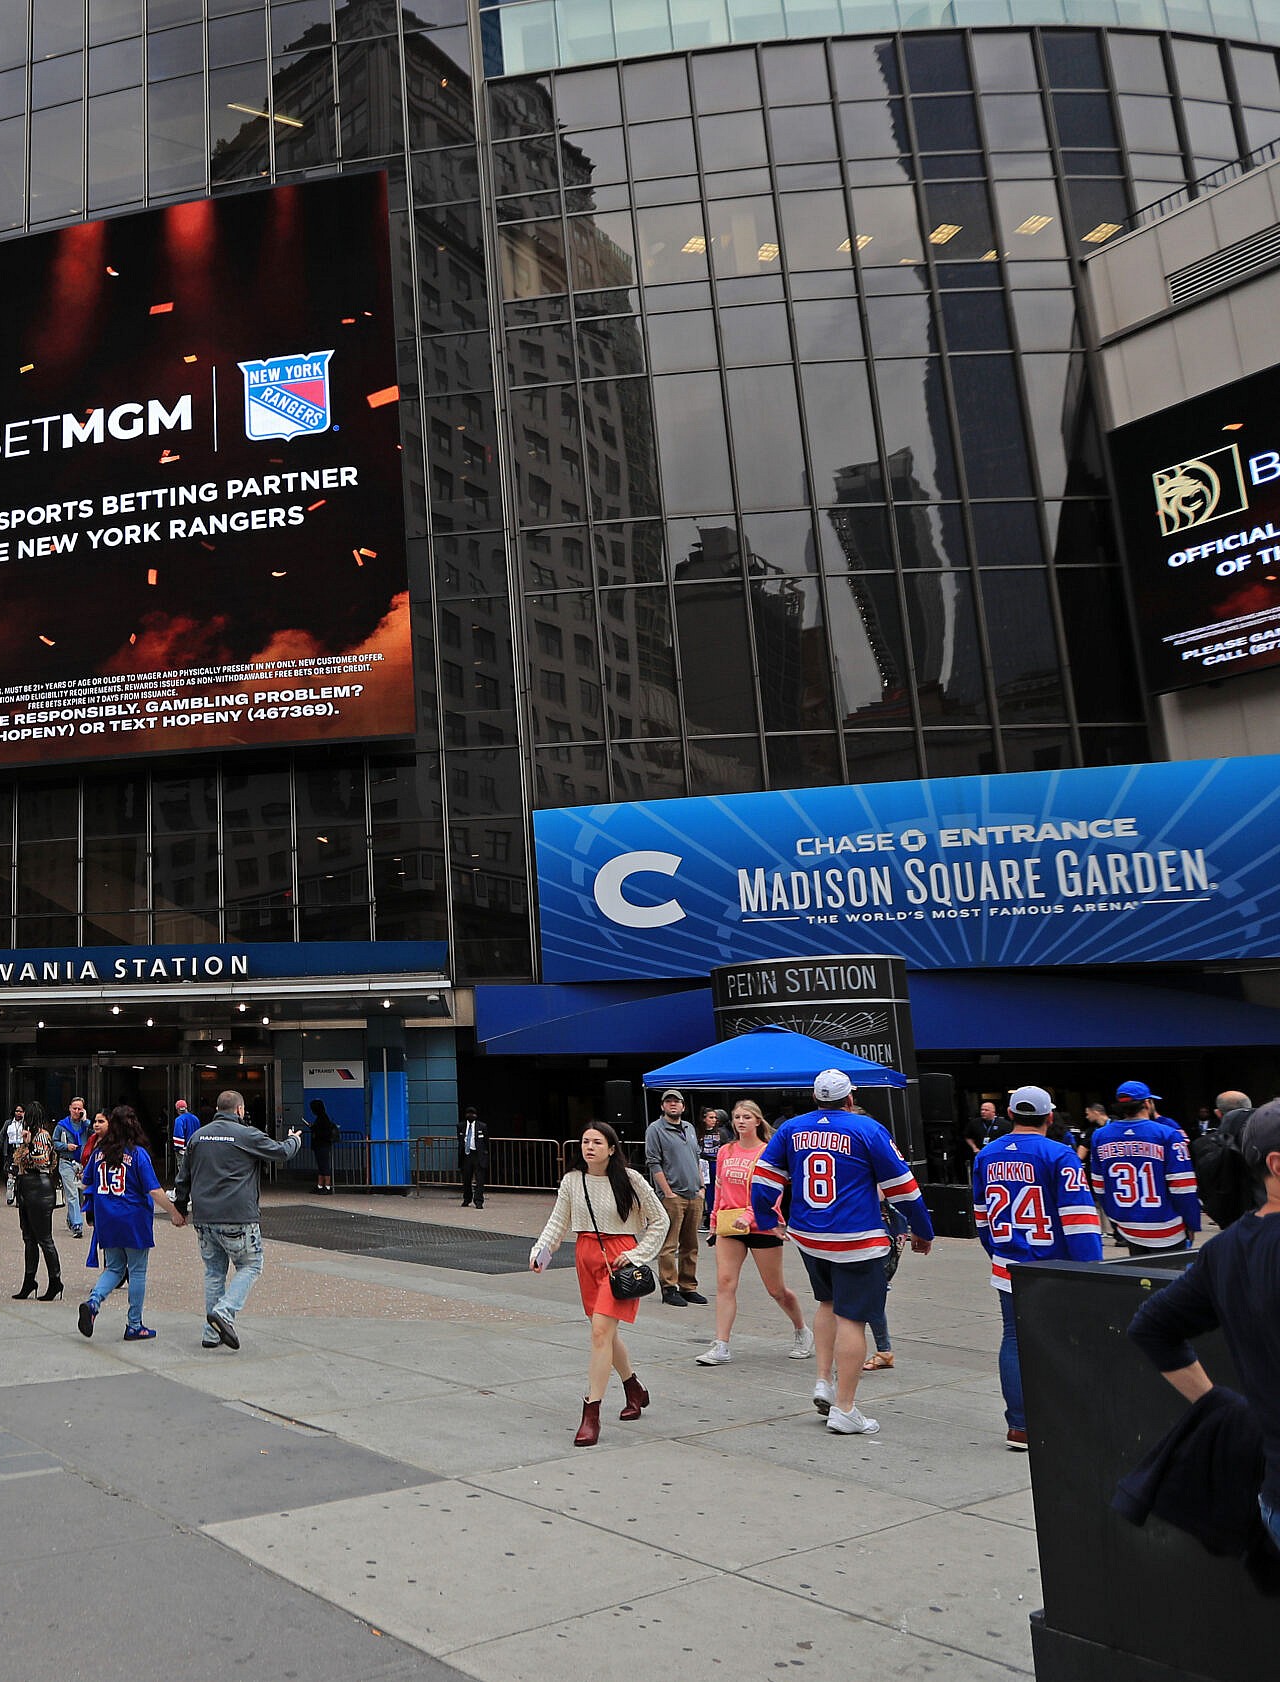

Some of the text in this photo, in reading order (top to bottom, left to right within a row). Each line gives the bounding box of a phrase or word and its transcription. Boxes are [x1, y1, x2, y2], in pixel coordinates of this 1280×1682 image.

[250, 362, 322, 384] NEW YORK
[260, 386, 323, 426] RANGERS
[102, 482, 218, 516] BETTING
[226, 466, 358, 500] PARTNER
[18, 532, 78, 559] NEW
[86, 521, 161, 549] YORK
[169, 505, 304, 540] RANGERS
[1216, 554, 1253, 577] OF
[1182, 636, 1248, 660] PLEASE
[1202, 650, 1248, 666] CALL
[4, 686, 23, 694] MUST
[24, 684, 32, 692] BE
[45, 682, 66, 690] YEARS
[78, 678, 92, 686] AGE
[92, 678, 102, 686] OR
[104, 676, 126, 684] OLDER
[136, 671, 161, 681] WAGER
[162, 670, 178, 679] AND
[180, 666, 220, 677] PHYSICALLY
[222, 664, 254, 673] PRESENT
[256, 662, 264, 670] IN
[265, 662, 276, 670] NY
[276, 660, 298, 668] ONLY.
[298, 658, 316, 666] NEW
[317, 654, 358, 666] CUSTOMER
[358, 653, 384, 662] OFFER.
[16, 694, 30, 702] AND
[31, 690, 68, 700] ELIGIBILITY
[70, 685, 124, 697] REQUIREMENTS.
[124, 682, 158, 692] REWARDS
[160, 679, 185, 688] ISSUED
[186, 678, 196, 686] AS
[197, 672, 273, 684] NON-WITHDRAWABLE
[274, 669, 292, 678] FREE
[294, 668, 312, 676] BETS
[314, 666, 324, 674] OR
[326, 666, 342, 674] SITE
[343, 664, 372, 672] CREDIT.
[14, 702, 140, 725] RESPONSIBLY.
[145, 694, 248, 713] GAMBLING
[254, 684, 364, 704] PROBLEM?
[28, 702, 44, 710] FREE
[45, 700, 62, 708] BETS
[62, 697, 86, 706] EXPIRE
[102, 694, 120, 702] DAYS
[120, 692, 140, 700] FROM
[141, 688, 178, 699] ISSUANCE.
[80, 722, 105, 734] OR
[109, 716, 158, 732] TEXT
[162, 710, 242, 728] HOPENY
[248, 702, 340, 722] (467369).
[796, 818, 1138, 856] CHASE ENTRANCE
[593, 850, 686, 928] C
[737, 866, 894, 913] MADISON
[904, 858, 1046, 907] SQUARE
[806, 914, 839, 925] THE
[846, 910, 925, 923] WORLD'S
[932, 908, 982, 920] MOST
[990, 904, 1065, 917] FAMOUS
[114, 955, 248, 979] STATION
[728, 965, 877, 998] PENN STATION
[792, 1131, 851, 1156] TROUBA
[97, 1161, 126, 1196] 13
[803, 1152, 836, 1208] 8
[987, 1162, 1035, 1183] KAKKO
[1060, 1167, 1090, 1192] 24
[1109, 1162, 1162, 1208] 31
[986, 1184, 1054, 1246] 24
